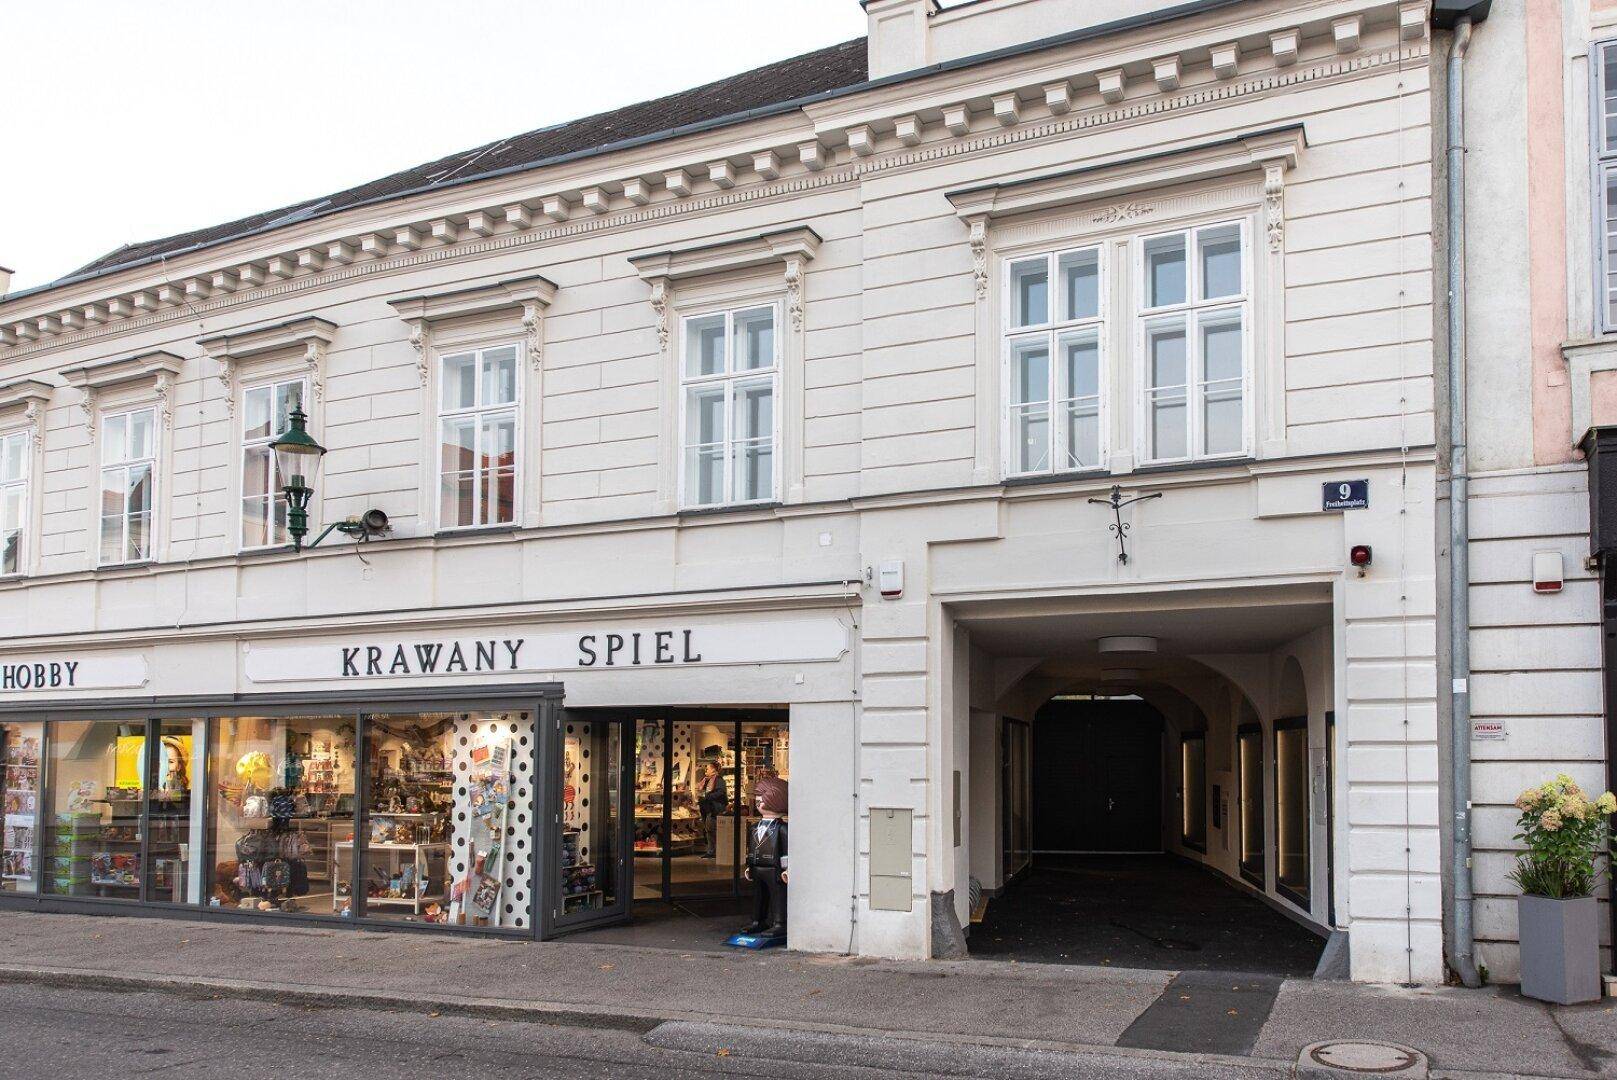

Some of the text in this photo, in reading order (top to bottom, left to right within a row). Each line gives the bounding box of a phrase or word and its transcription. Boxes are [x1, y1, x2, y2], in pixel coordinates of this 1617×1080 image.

[1339, 483, 1352, 500] 9
[342, 629, 702, 676] KRAWANY SPIEL
[2, 661, 79, 689] HOBBY
